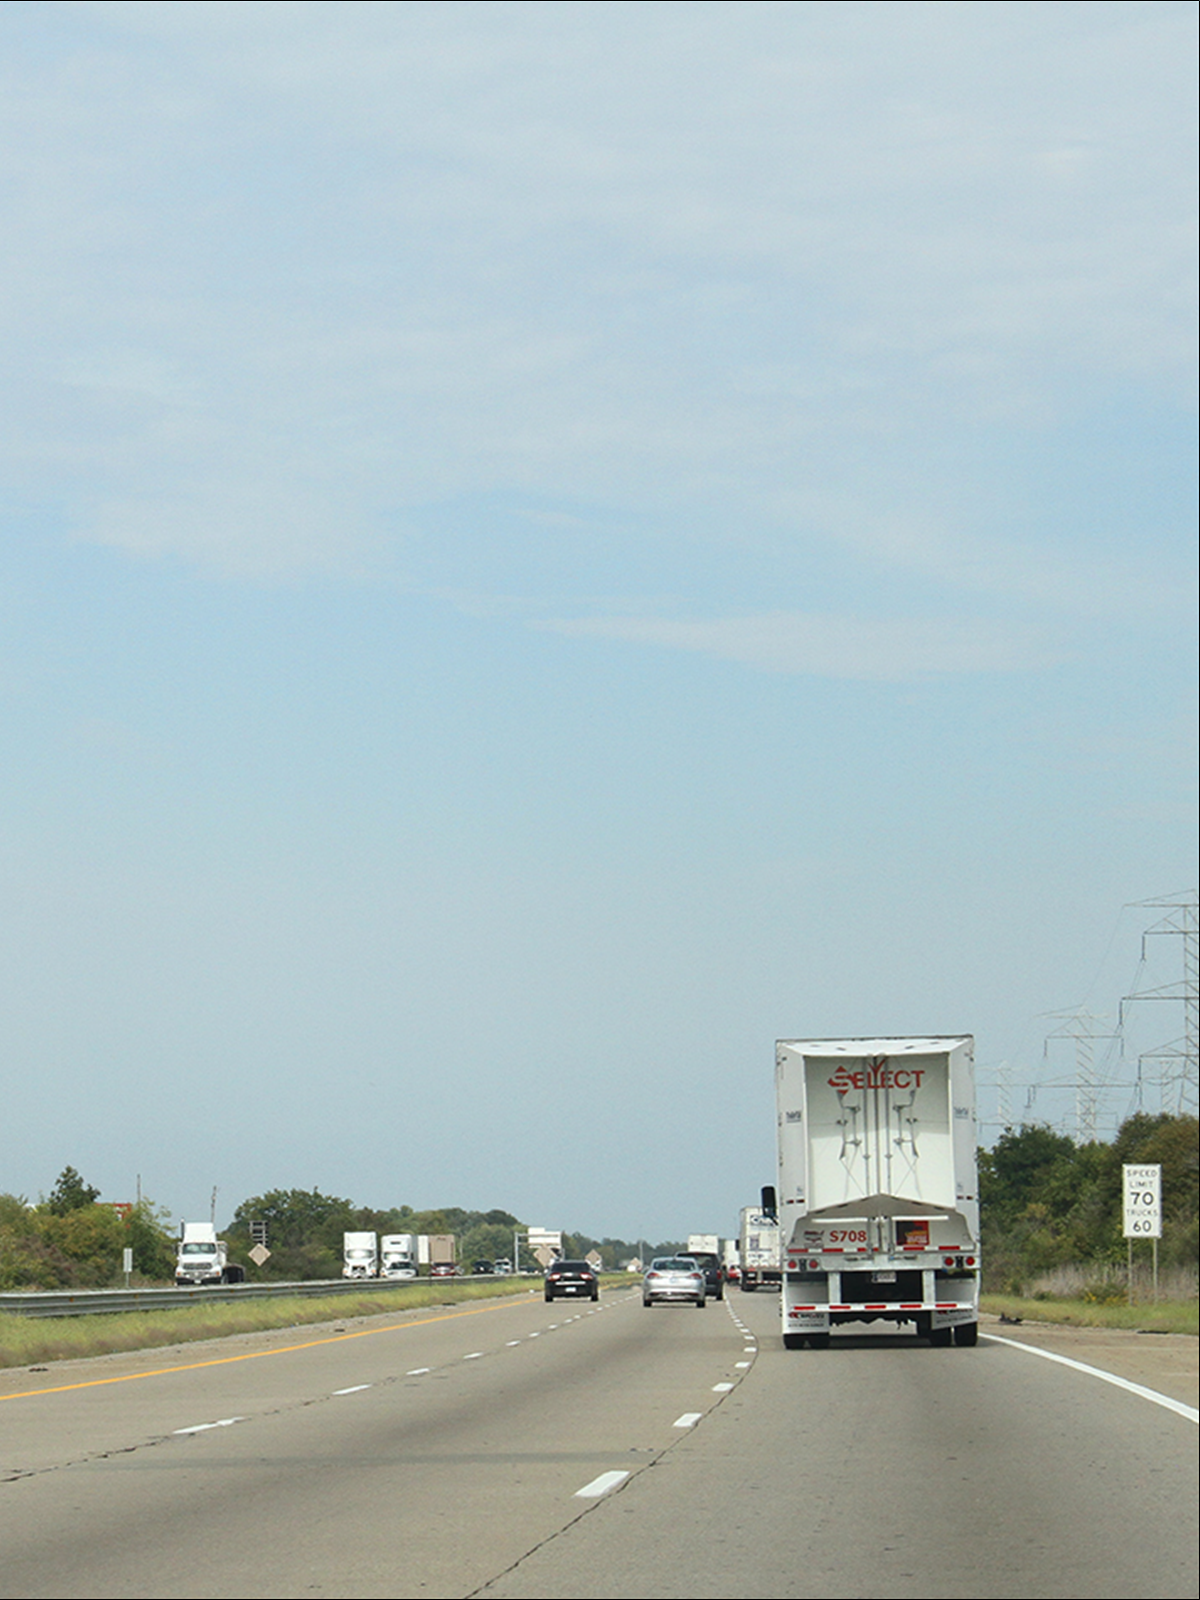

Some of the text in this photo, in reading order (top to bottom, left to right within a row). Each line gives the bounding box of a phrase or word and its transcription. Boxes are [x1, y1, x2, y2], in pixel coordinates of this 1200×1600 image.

[827, 1060, 925, 1096] SELECT
[1126, 1169, 1157, 1177] SPEED
[1130, 1191, 1154, 1205] 70
[1133, 1219, 1152, 1232] 60
[829, 1230, 867, 1243] S708
